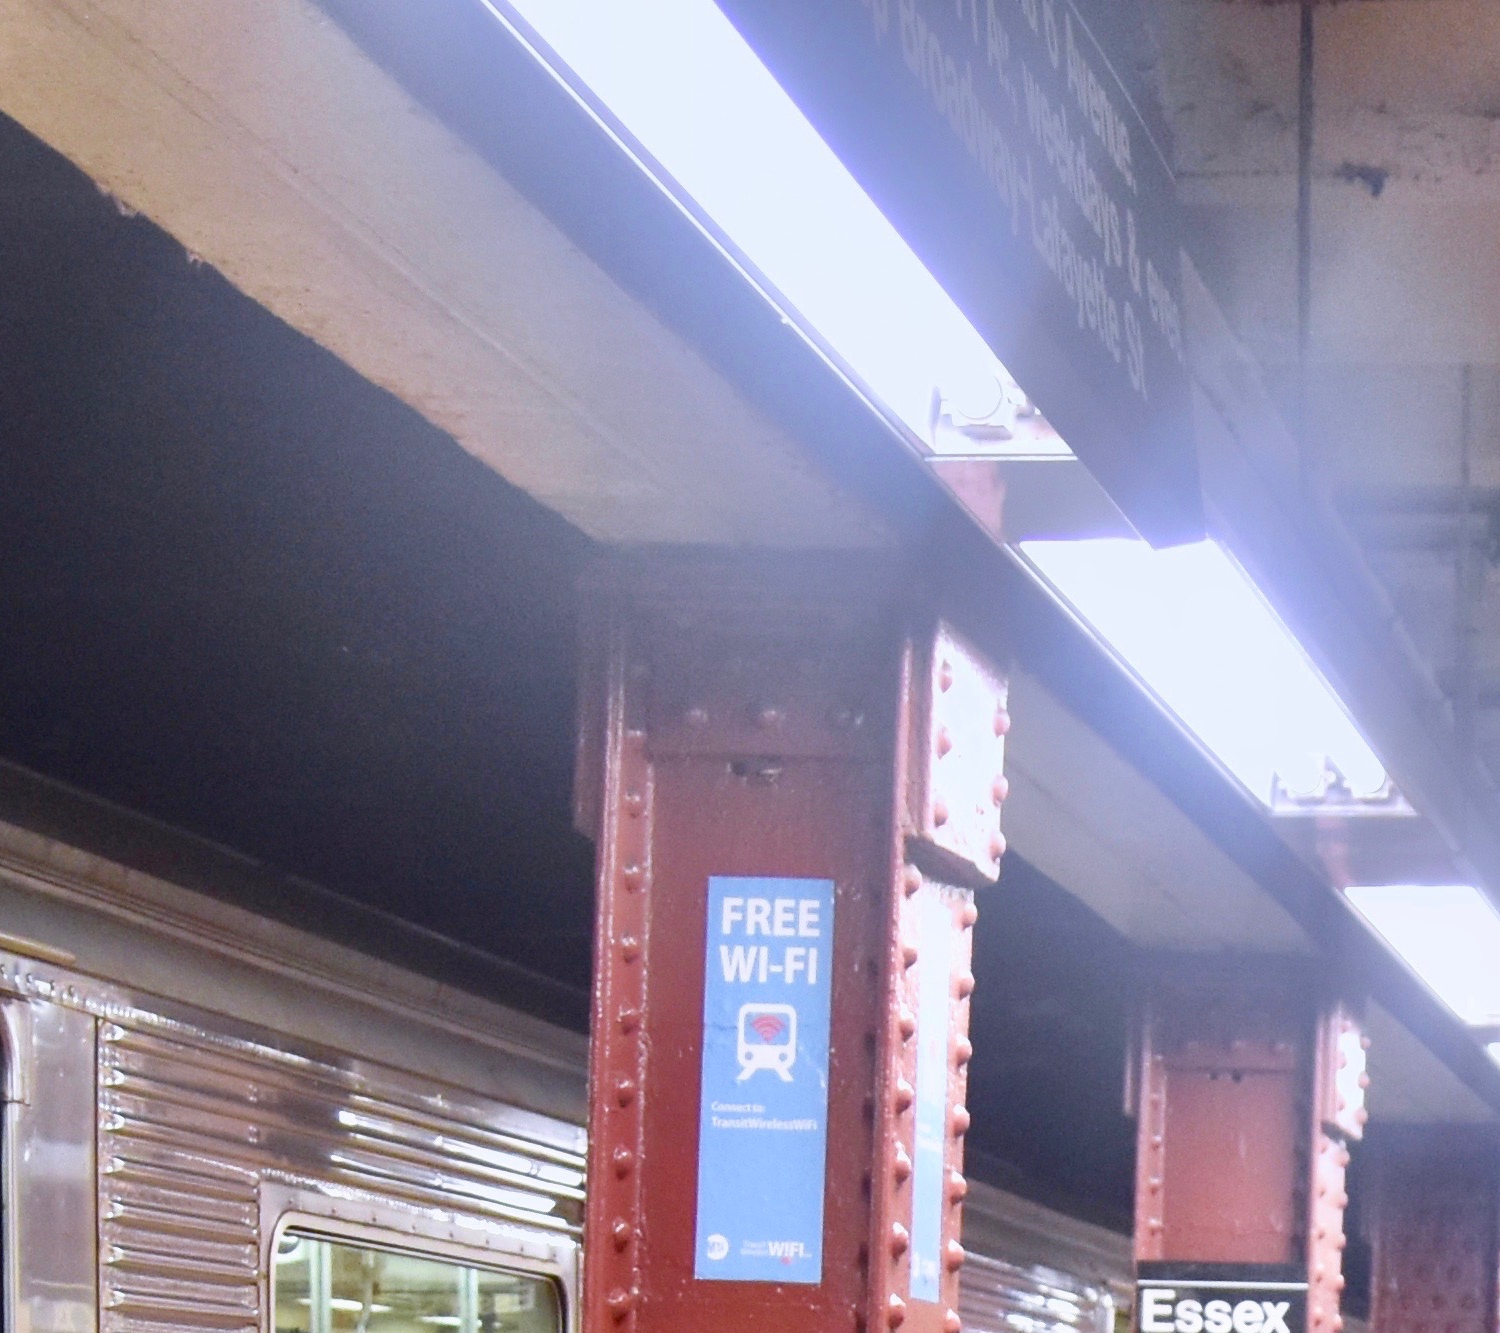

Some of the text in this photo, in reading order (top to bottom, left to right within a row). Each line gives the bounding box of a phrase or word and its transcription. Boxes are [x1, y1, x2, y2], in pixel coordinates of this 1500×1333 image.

[1022, 60, 1122, 267] weekdays
[1122, 301, 1149, 402] St
[721, 897, 820, 938] FREE
[719, 944, 818, 985] WI-FI
